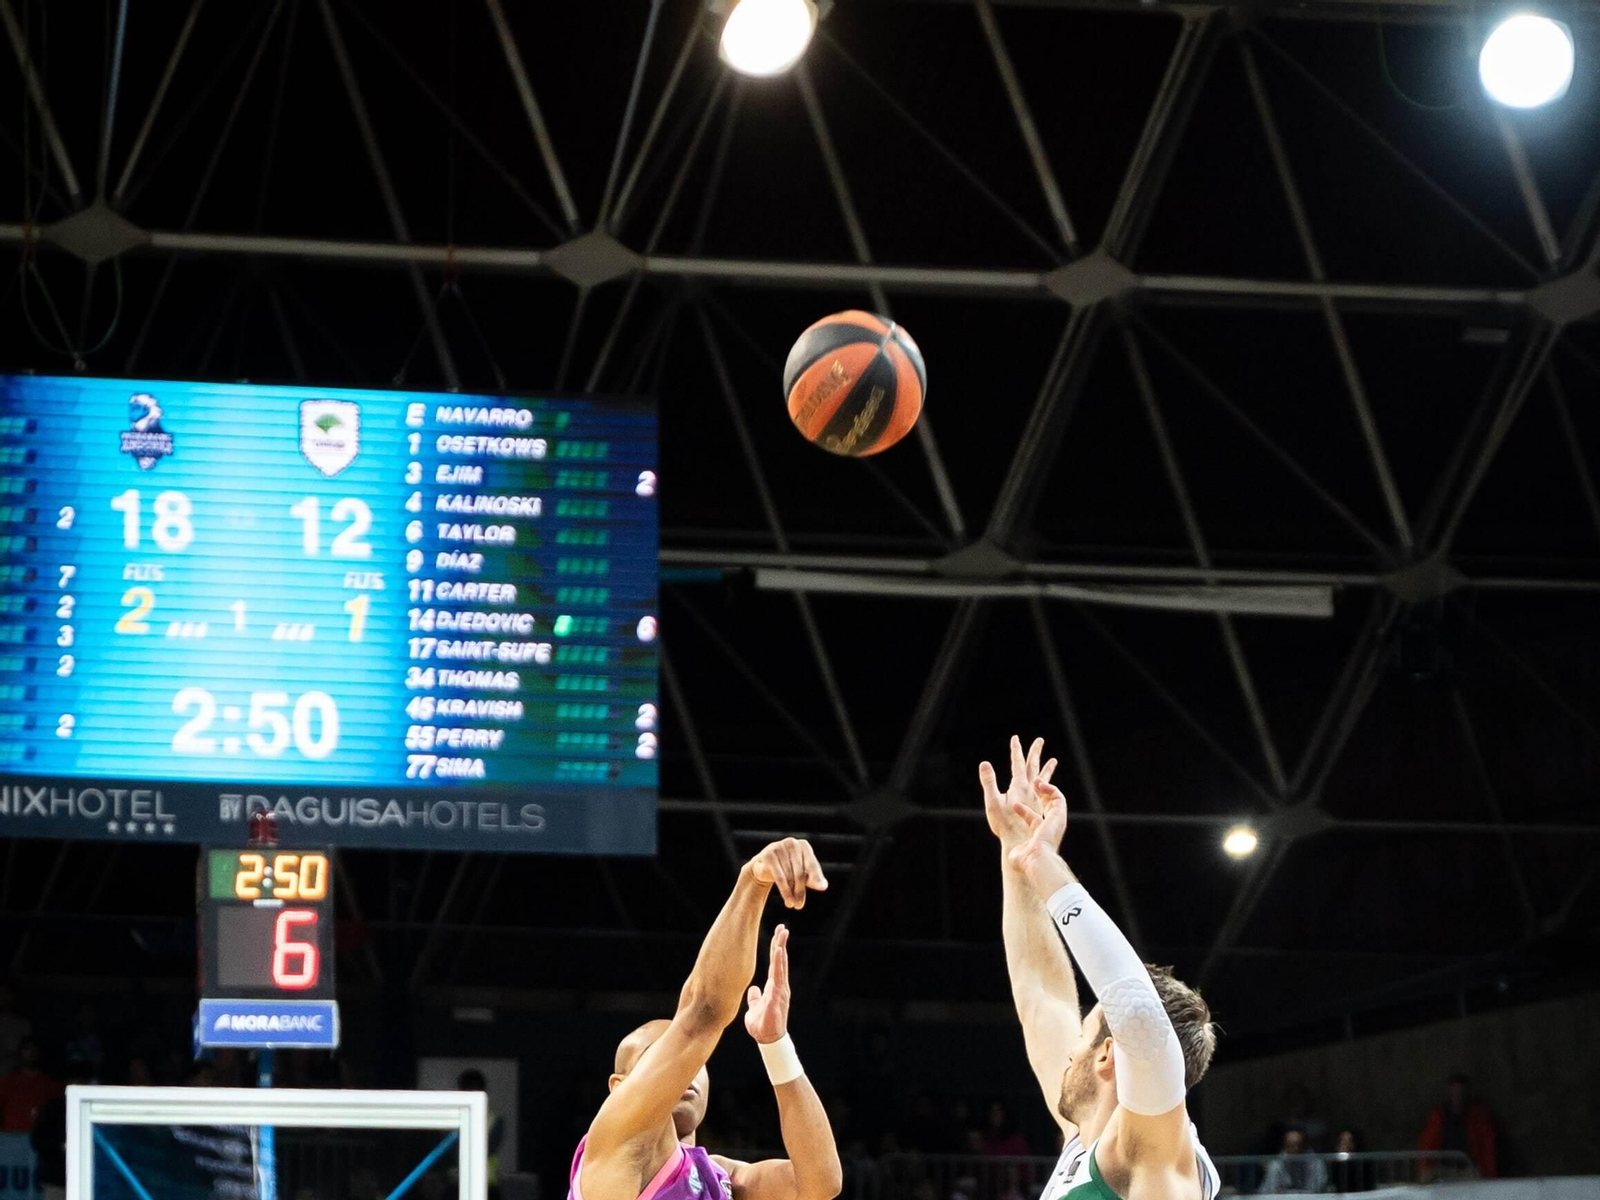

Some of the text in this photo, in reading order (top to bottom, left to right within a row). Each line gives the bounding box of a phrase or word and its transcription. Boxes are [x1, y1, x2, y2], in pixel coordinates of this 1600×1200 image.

[436, 406, 533, 429] NAVARRO
[408, 432, 548, 460] 1 OSETKOWS
[405, 461, 422, 485] 3
[636, 470, 656, 496] 2
[405, 491, 422, 514] 4
[57, 506, 75, 529] 2
[111, 489, 195, 551] 18
[289, 496, 373, 558] 12
[438, 523, 516, 546] TAYLOR
[406, 549, 424, 573] 9
[58, 566, 76, 588] 7
[408, 579, 517, 605] 11 CARTER
[56, 595, 75, 618] 2
[114, 586, 155, 635] 2
[229, 600, 247, 633] 1
[343, 593, 371, 643] 1
[57, 625, 74, 647] 3
[408, 608, 657, 642] 14 DJEDOVIC 6
[408, 637, 437, 660] 17
[56, 655, 75, 677] 2
[405, 666, 520, 692] 34 THOMAS
[56, 714, 75, 738] 2
[172, 687, 340, 760] 2:50
[405, 696, 656, 730] 45 KRAVISH 2
[405, 725, 656, 759] 55 PERRY 2
[406, 754, 486, 779] 77 SIMA
[235, 853, 329, 900] 2:50
[273, 908, 320, 990] 6
[230, 1014, 324, 1032] MORABANC
